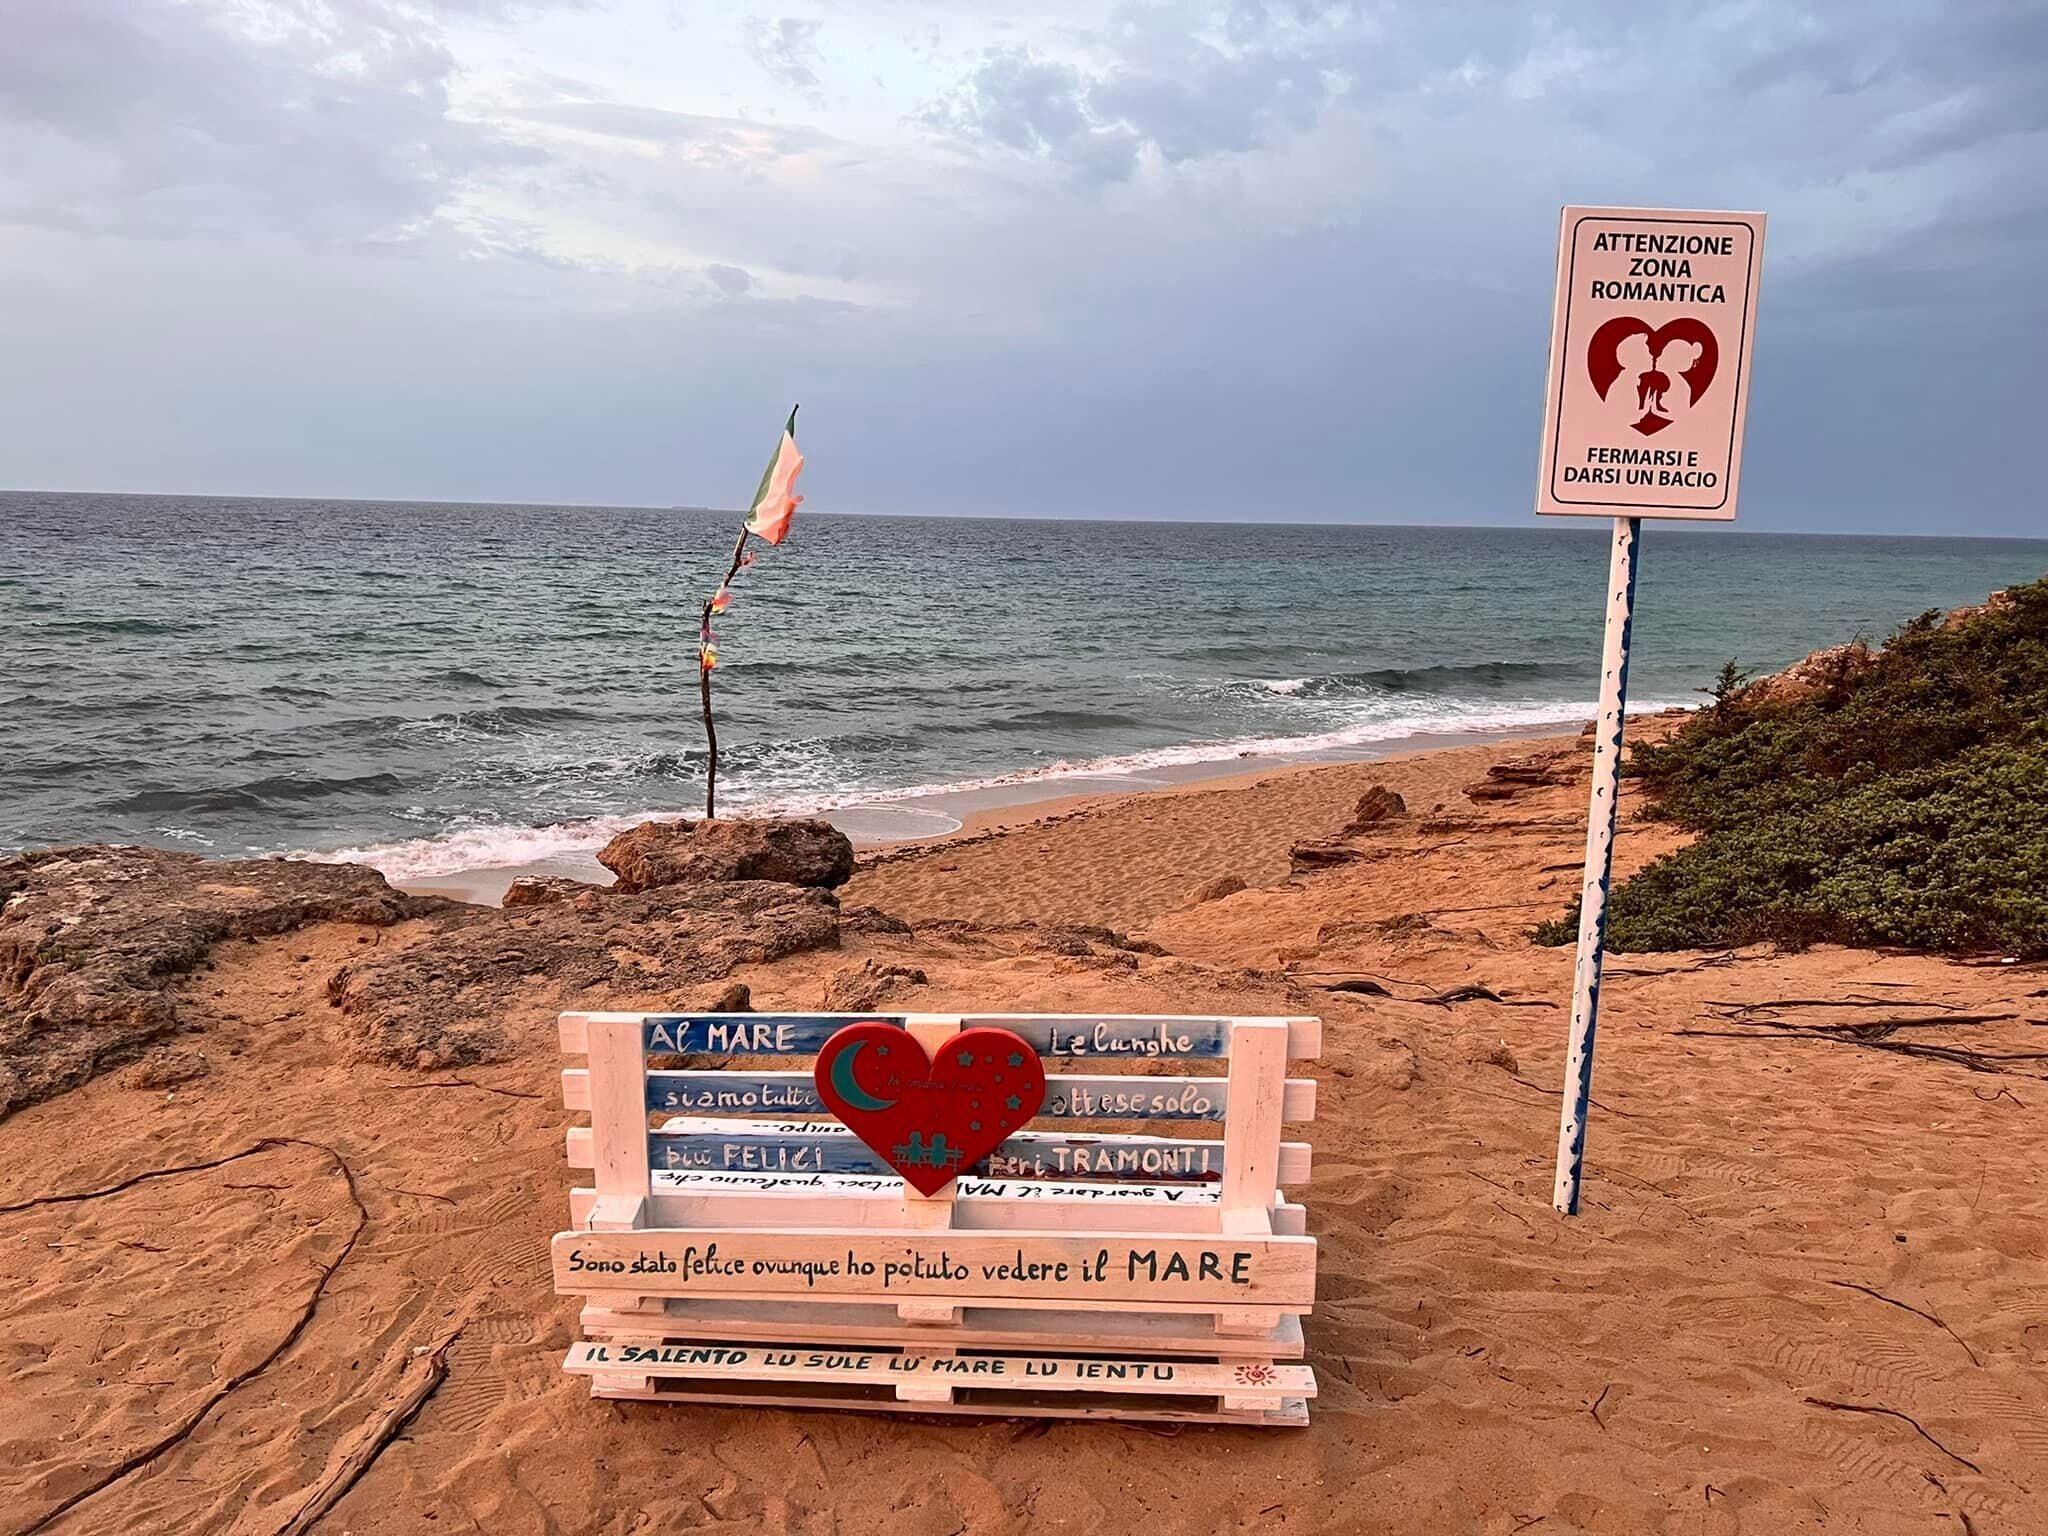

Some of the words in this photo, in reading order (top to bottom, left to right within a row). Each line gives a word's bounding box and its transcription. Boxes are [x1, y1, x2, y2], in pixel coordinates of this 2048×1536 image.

[1593, 232, 1733, 256] ATTENZIONE
[1629, 258, 1692, 279] ZONA
[1591, 281, 1726, 304] ROMANTICA
[1587, 448, 1682, 467] FERMARSI
[1687, 452, 1698, 467] E
[1563, 467, 1620, 484] DARSI
[1626, 470, 1653, 486] UN
[1659, 471, 1717, 488] BACIO
[651, 1022, 690, 1052] Al
[707, 1023, 795, 1051] MARE
[1094, 1022, 1194, 1057] lunghe
[722, 1141, 822, 1171] FELICI
[1052, 1147, 1209, 1174] TRAMONTI
[569, 1250, 625, 1272] Sono
[630, 1250, 677, 1273] stato
[683, 1243, 745, 1281] felice
[752, 1261, 840, 1286] ovunque
[847, 1250, 876, 1275] ho
[884, 1250, 969, 1287] potuto
[982, 1249, 1068, 1281] vedere
[1082, 1250, 1108, 1281] il
[1128, 1250, 1251, 1284] MARE
[586, 1347, 609, 1361] IL
[619, 1347, 747, 1365] SALENTO
[764, 1353, 795, 1366] LU
[804, 1355, 872, 1369] SULE
[932, 1360, 1005, 1374] MARE
[1025, 1362, 1057, 1376] LU
[1076, 1363, 1173, 1380] IENTU
